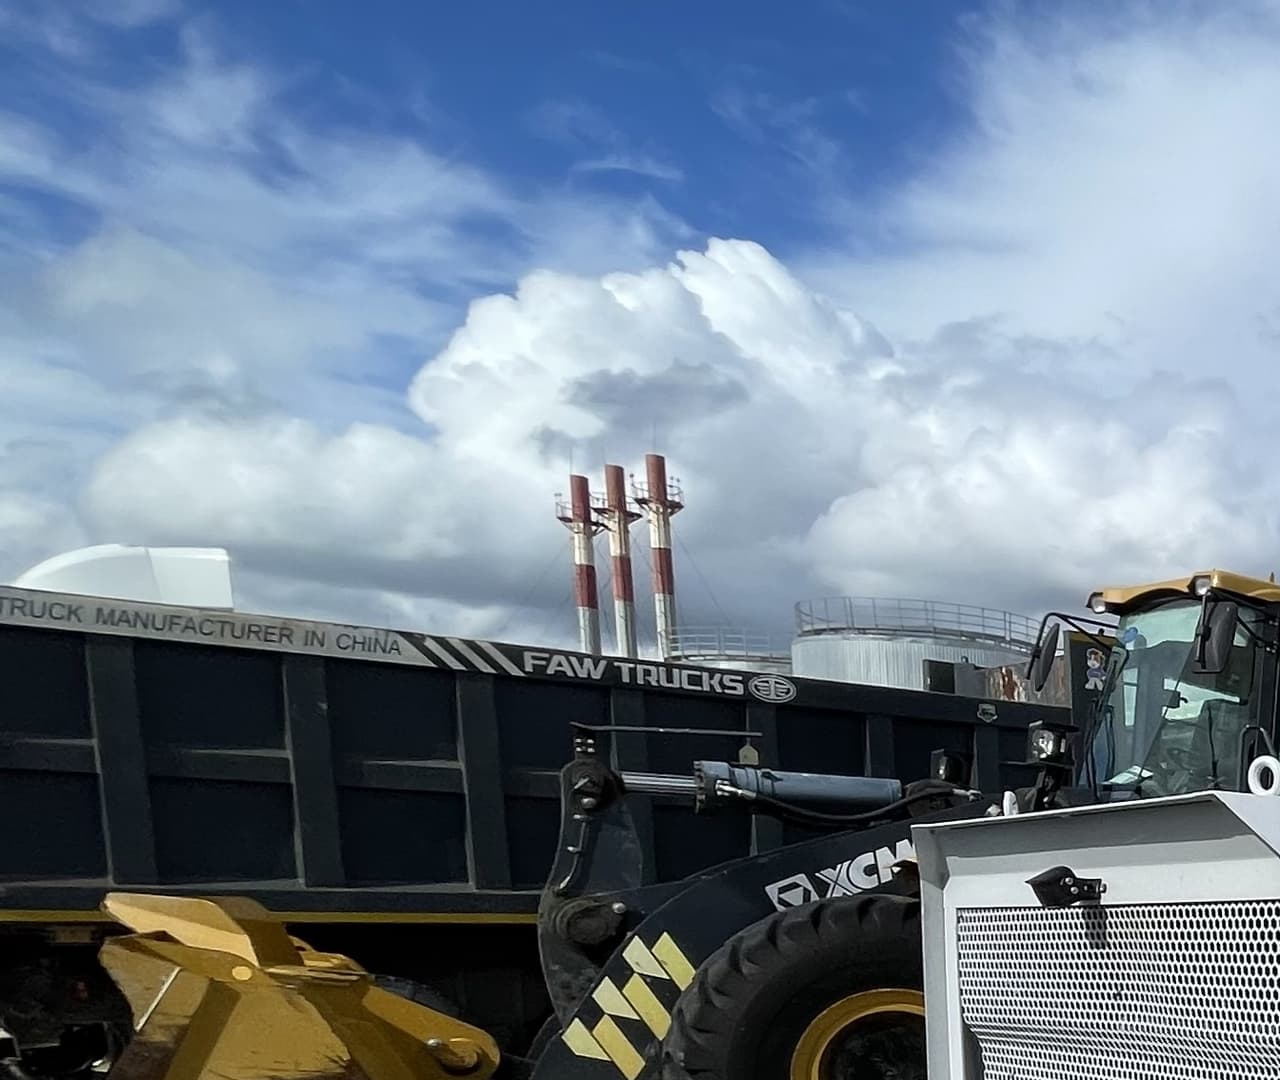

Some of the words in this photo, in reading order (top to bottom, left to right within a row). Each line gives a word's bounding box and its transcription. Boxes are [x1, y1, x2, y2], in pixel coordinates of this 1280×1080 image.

[95, 606, 294, 645] MANUFACTURER
[303, 630, 326, 648] IN
[336, 633, 401, 656] CHINA
[523, 650, 607, 679] FAW
[613, 661, 744, 696] TRUCKS
